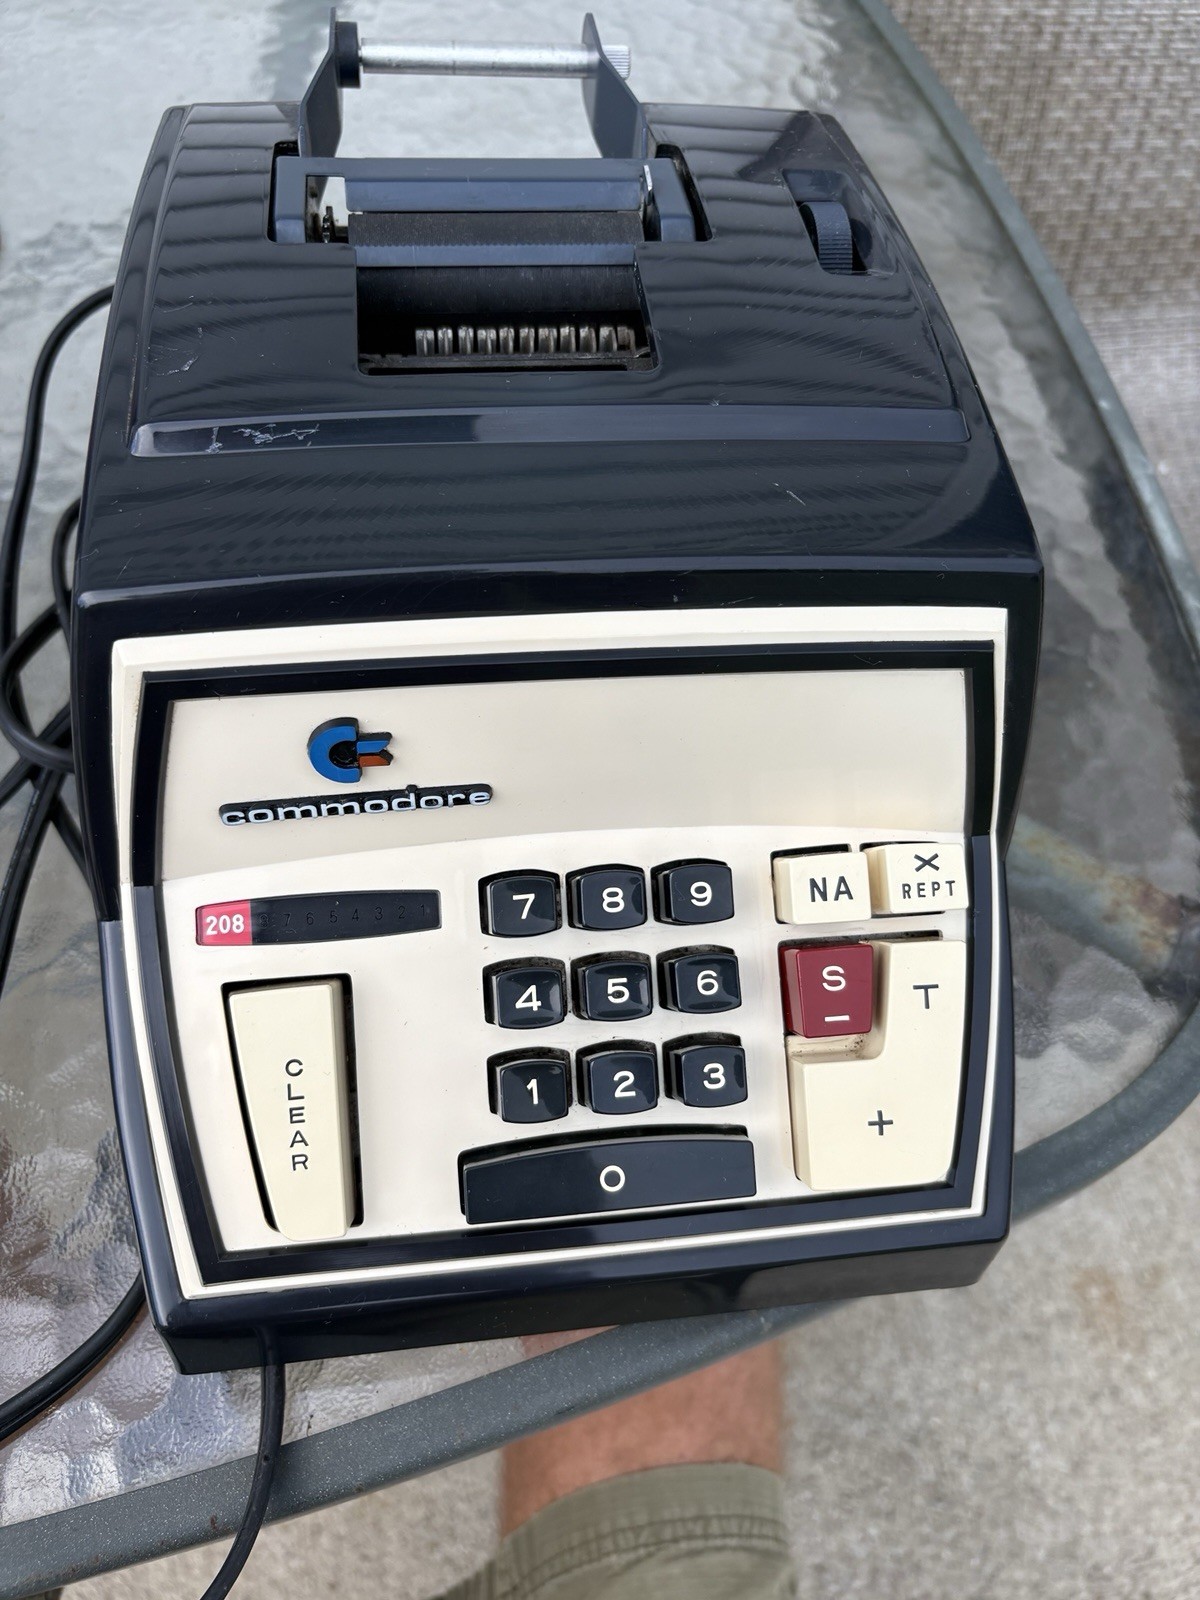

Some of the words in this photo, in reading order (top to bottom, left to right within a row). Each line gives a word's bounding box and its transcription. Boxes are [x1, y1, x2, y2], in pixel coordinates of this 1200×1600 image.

[222, 785, 492, 826] commodore
[602, 887, 625, 914] 8
[690, 881, 712, 907] 9
[809, 875, 854, 903] NA
[902, 880, 956, 899] REPT
[283, 912, 292, 926] 7
[306, 912, 315, 926] 6
[329, 910, 338, 924] 5
[352, 908, 360, 921] 4
[375, 907, 383, 920] 3
[398, 906, 406, 919] 2
[512, 893, 536, 919] 7
[206, 914, 245, 936] 208
[607, 977, 630, 1004] 5
[696, 970, 719, 996] 6
[822, 965, 847, 992] S
[515, 984, 542, 1011] 4
[913, 983, 939, 1009] T
[613, 1071, 636, 1098] 2
[703, 1063, 726, 1089] 3
[526, 1078, 539, 1105] 1
[285, 1059, 309, 1171] CLEAR
